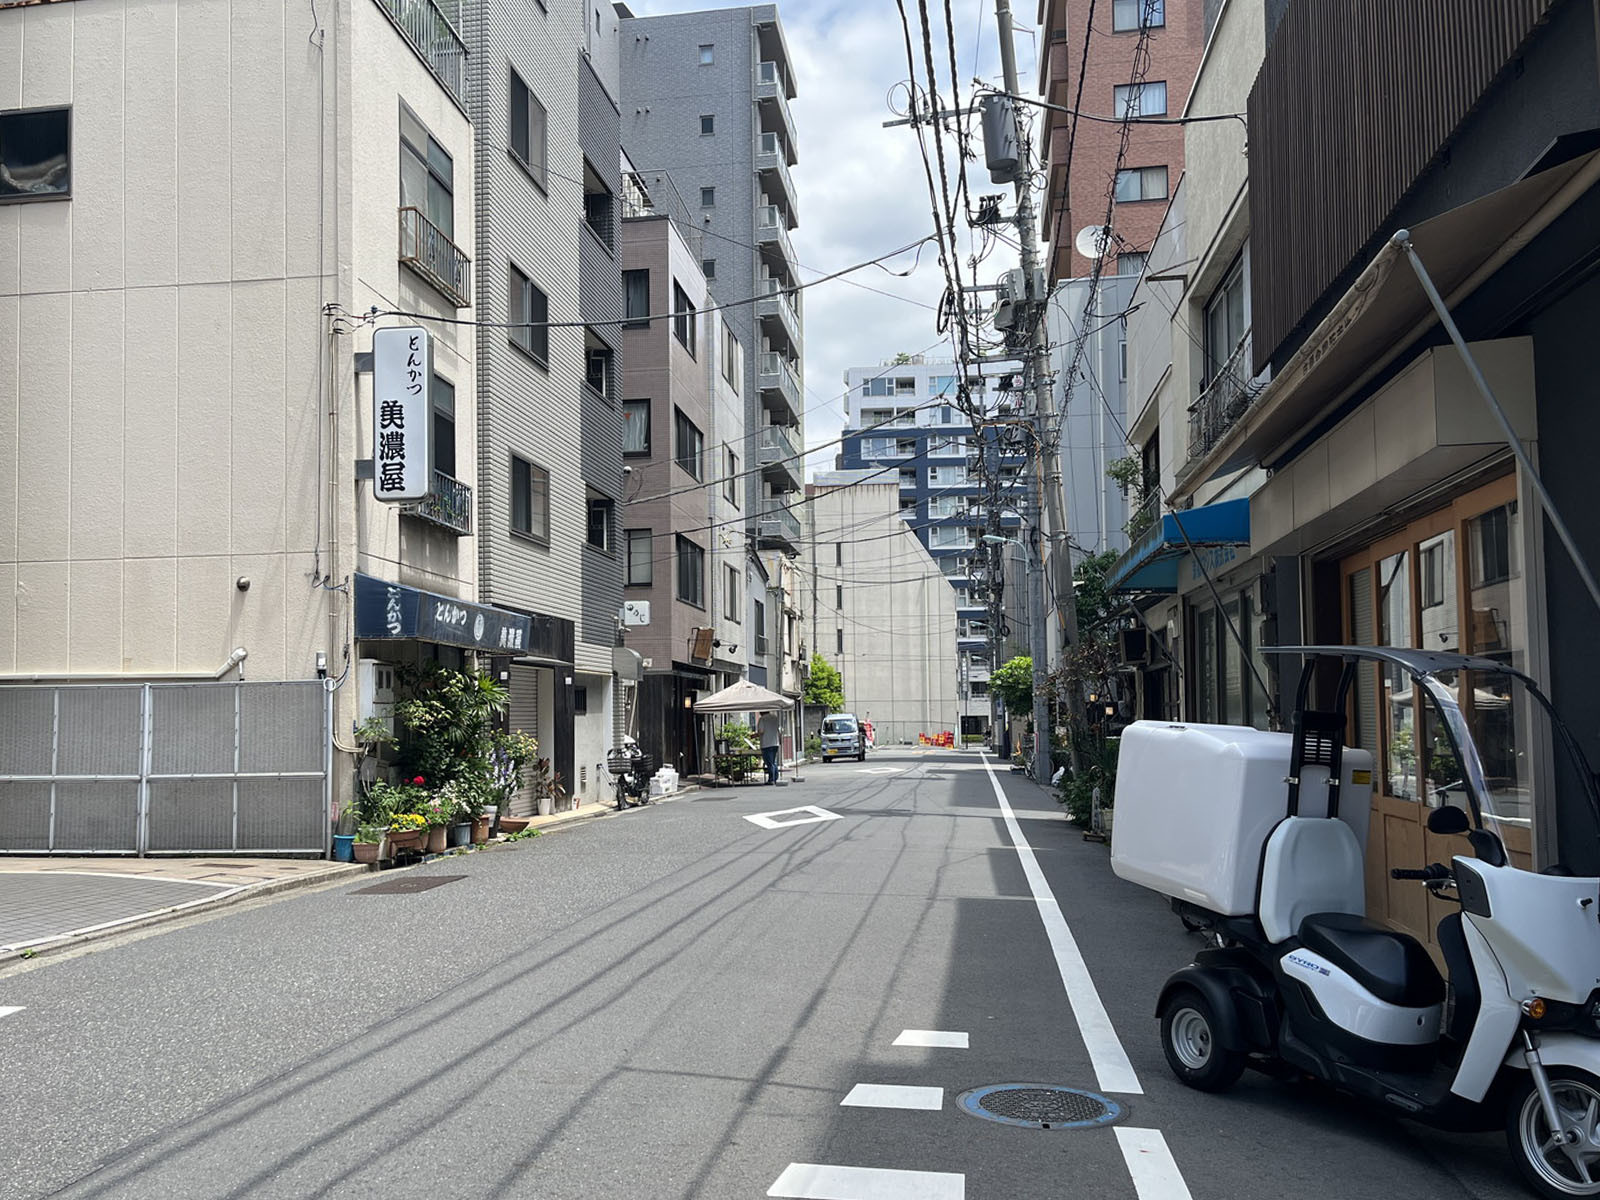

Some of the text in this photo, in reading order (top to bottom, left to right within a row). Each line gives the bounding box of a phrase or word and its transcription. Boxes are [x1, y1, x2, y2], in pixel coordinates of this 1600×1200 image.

[406, 335, 423, 396] とんかつ
[380, 401, 405, 492] 美濃屋
[436, 602, 467, 625] とんかつ
